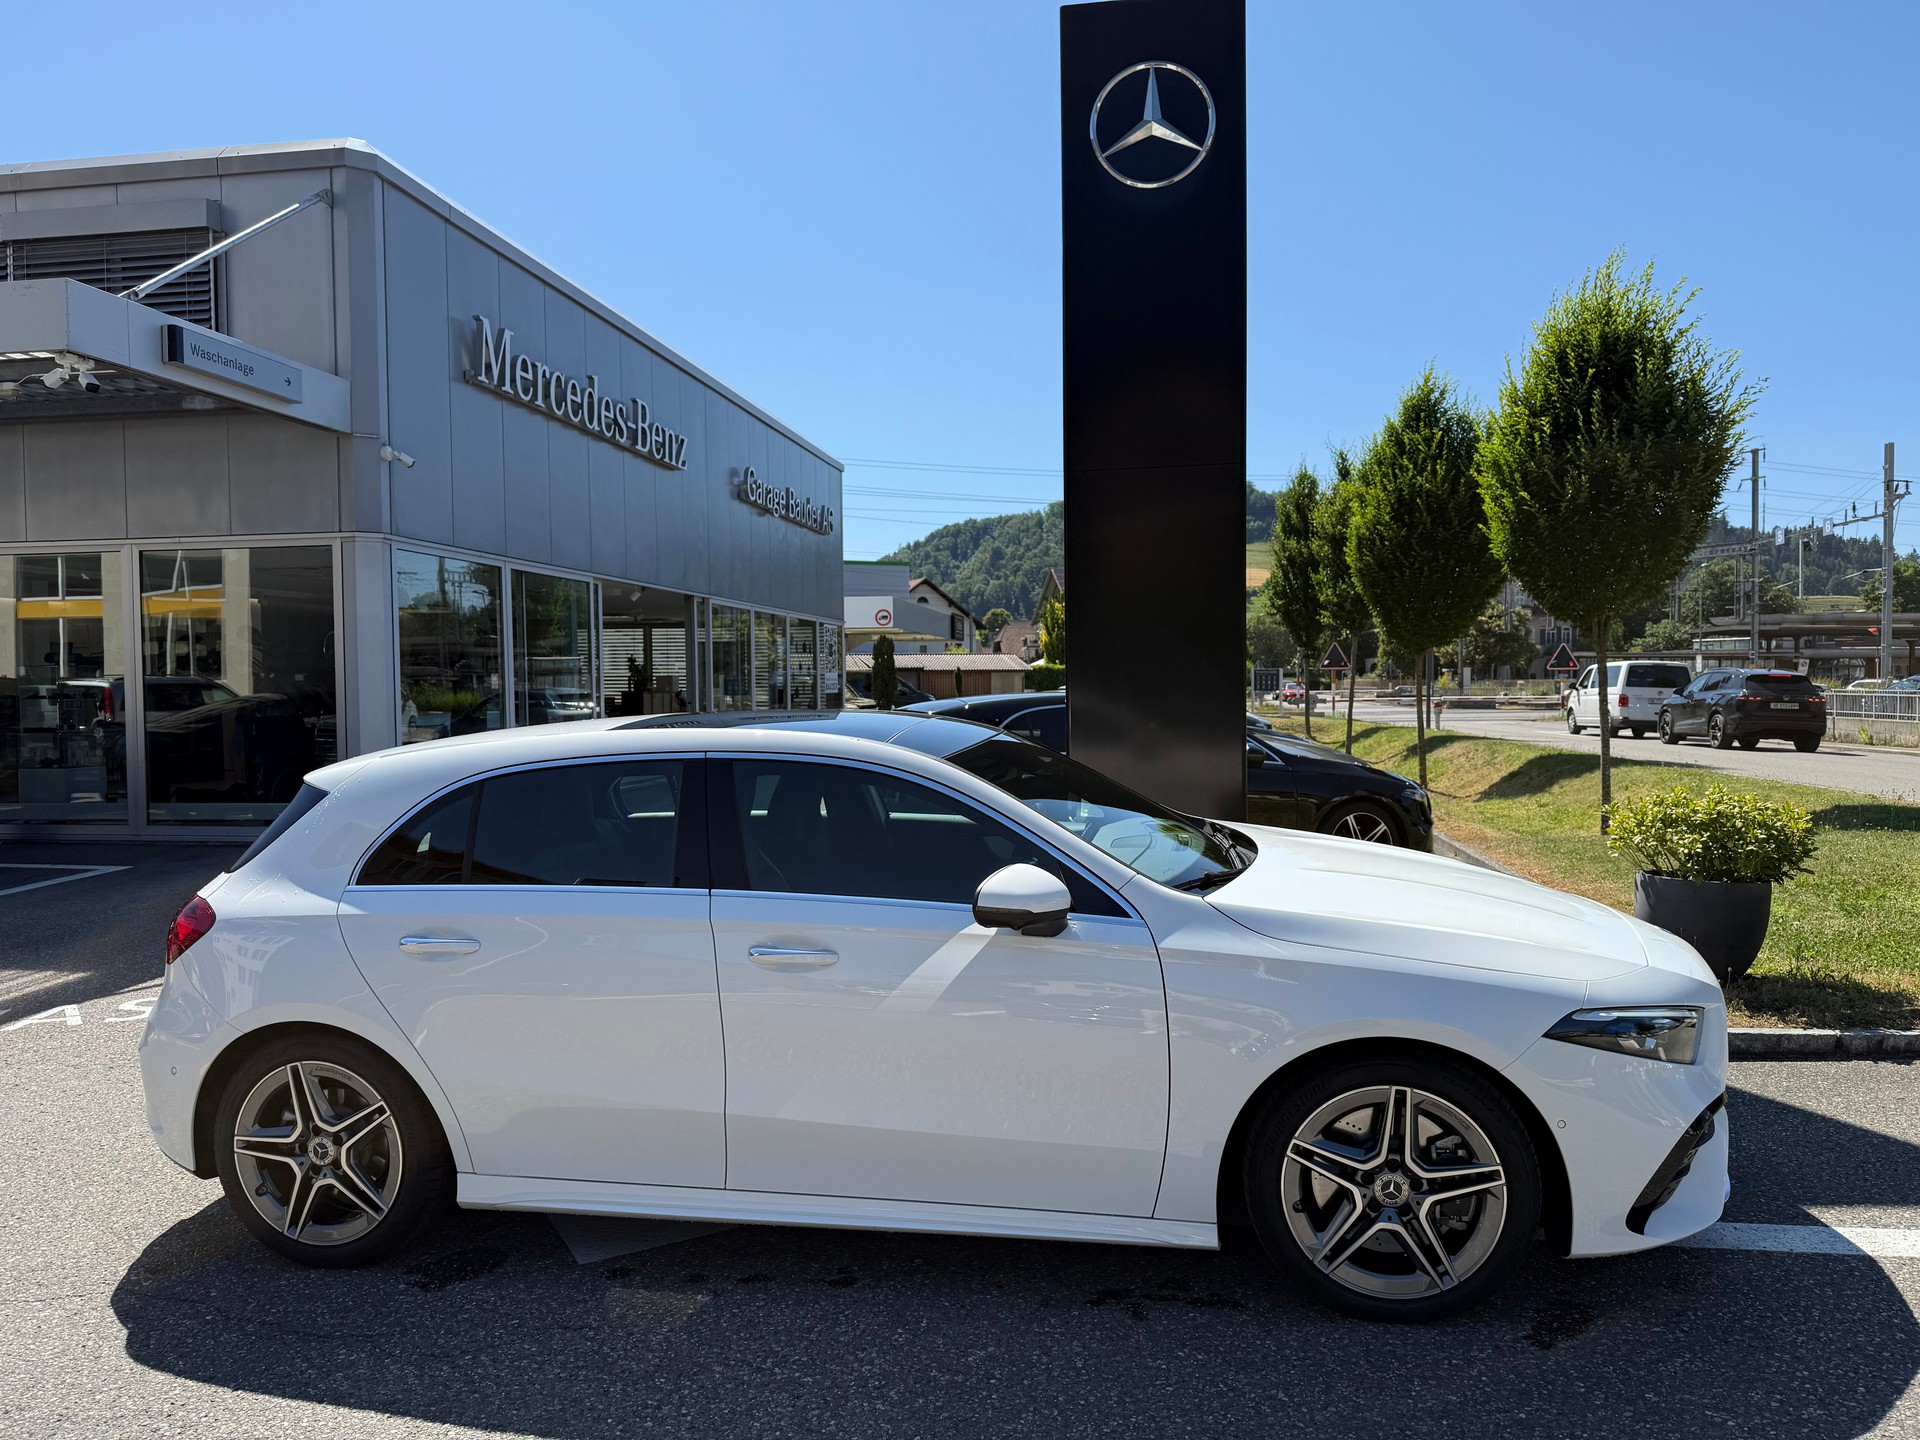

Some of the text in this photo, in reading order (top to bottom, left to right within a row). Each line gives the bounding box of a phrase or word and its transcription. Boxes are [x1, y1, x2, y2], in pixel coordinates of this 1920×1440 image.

[189, 342, 255, 377] Waschanlage
[474, 314, 688, 471] Mercedes-Benz
[745, 466, 835, 534] Garage Bauder AG
